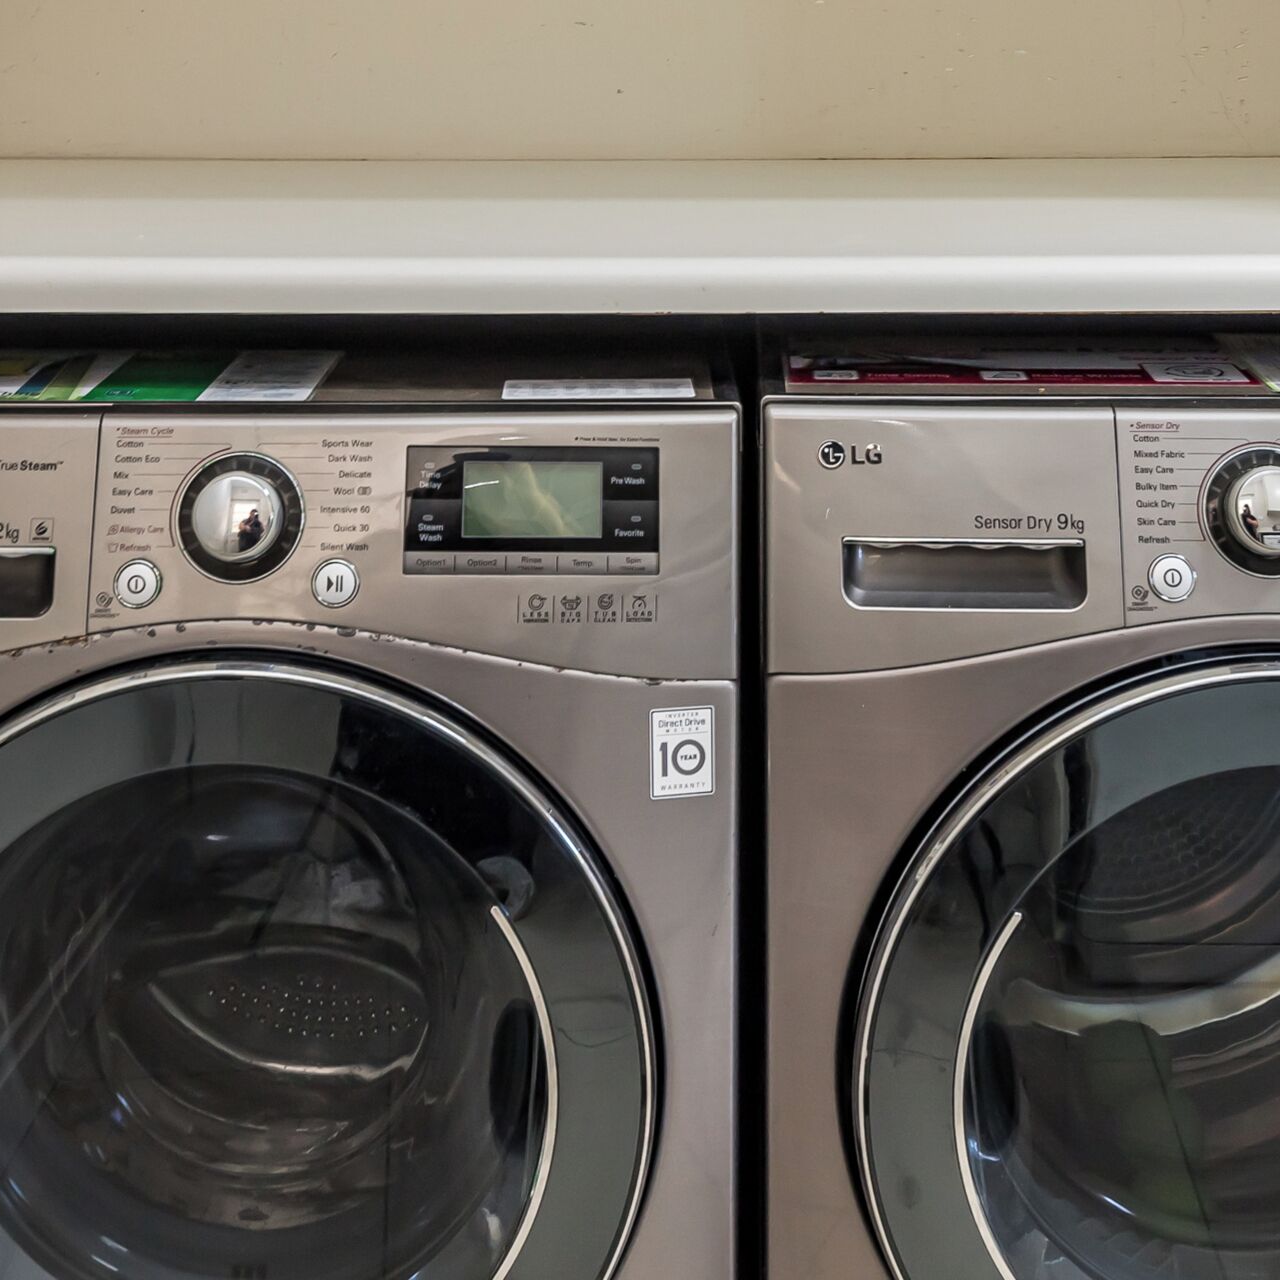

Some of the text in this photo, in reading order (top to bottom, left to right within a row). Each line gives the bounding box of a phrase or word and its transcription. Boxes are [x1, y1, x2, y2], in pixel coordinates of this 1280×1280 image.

[1135, 422, 1180, 430] Sensor Dry
[121, 427, 174, 437] Steam Cycle
[1133, 434, 1160, 442] Cotton
[116, 440, 144, 448] Cotton
[321, 439, 373, 448] Sports Wear
[850, 444, 882, 465] LG
[1133, 450, 1185, 458] Mixed Fabric
[115, 455, 160, 463] Cotton Eco
[328, 454, 373, 463] Dark Wash
[338, 470, 372, 478] Delicate
[1134, 466, 1174, 475] Easy Care
[421, 471, 441, 479] Time
[624, 477, 645, 485] Wash
[419, 481, 442, 490] Delay
[1135, 482, 1178, 491] Bulky Item
[112, 488, 153, 497] Easy Care
[333, 487, 355, 495] Wool
[1136, 500, 1175, 509] Quick Dry
[110, 506, 135, 514] Duvet
[320, 506, 358, 514] Intensive
[974, 514, 1085, 534] Sensor Dry 9kg
[1137, 518, 1176, 526] Skin Care
[120, 525, 164, 535] Allergy Care
[333, 524, 369, 532] Quick 30
[418, 523, 444, 531] Steam
[614, 528, 644, 537] Favorite
[419, 533, 442, 542] Wash
[1138, 536, 1170, 544] Refresh
[119, 543, 151, 551] Refresh
[320, 543, 369, 551] Silent Wash
[416, 558, 446, 567] Option1
[467, 558, 497, 567] Option2
[625, 557, 642, 565] Spin
[658, 718, 706, 728] Direct Drive
[659, 739, 706, 777] 10
[661, 782, 706, 791] WARRANTY
